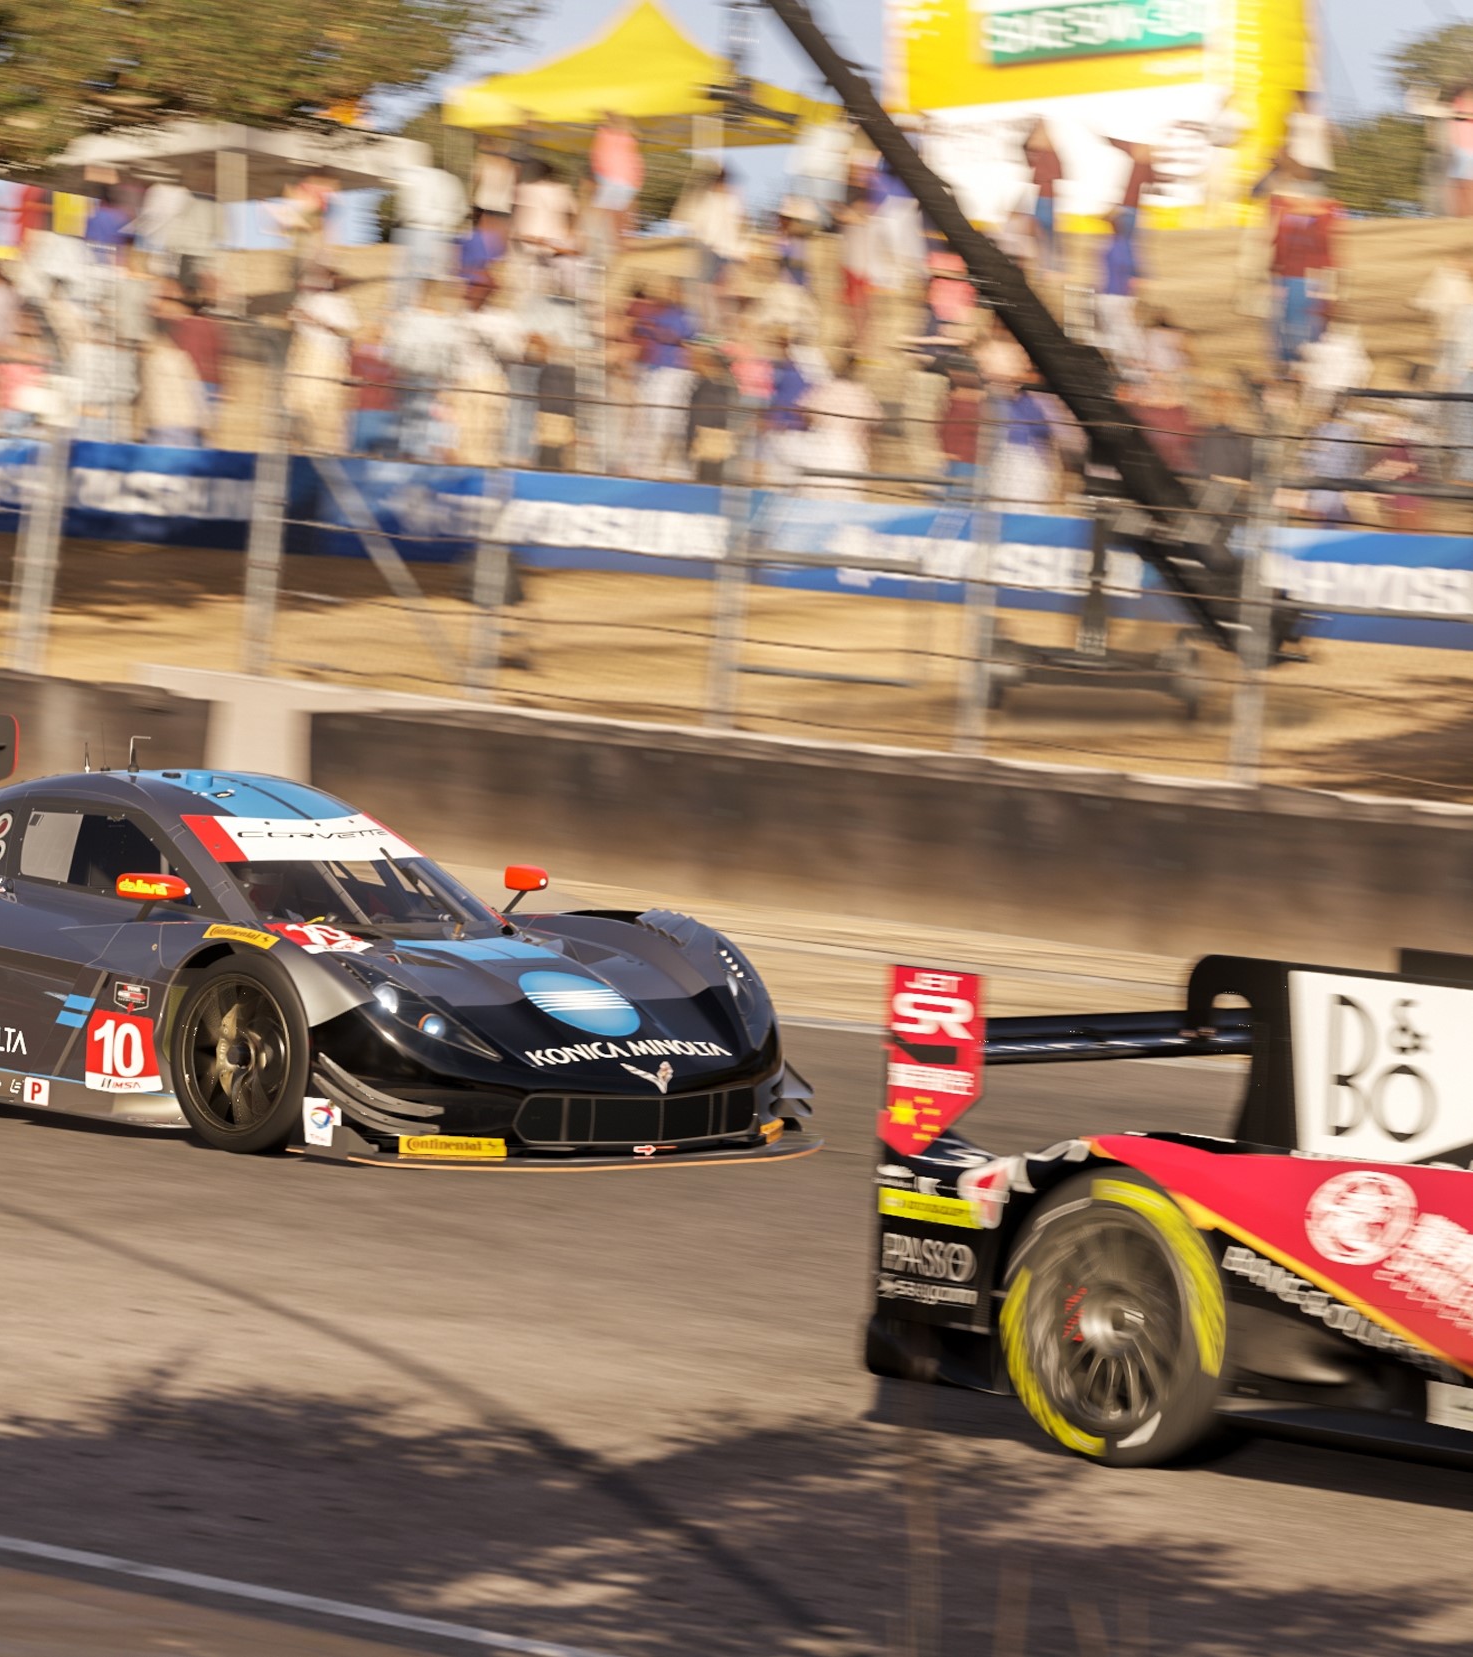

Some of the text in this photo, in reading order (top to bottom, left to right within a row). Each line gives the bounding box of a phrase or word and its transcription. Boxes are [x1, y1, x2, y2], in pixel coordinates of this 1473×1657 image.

[237, 828, 388, 839] CORVETTE
[210, 926, 262, 941] Continental
[94, 1019, 144, 1077] 10
[525, 1039, 732, 1067] KONICA MINOLTA
[32, 1083, 42, 1100] P
[407, 1137, 481, 1151] Continental
